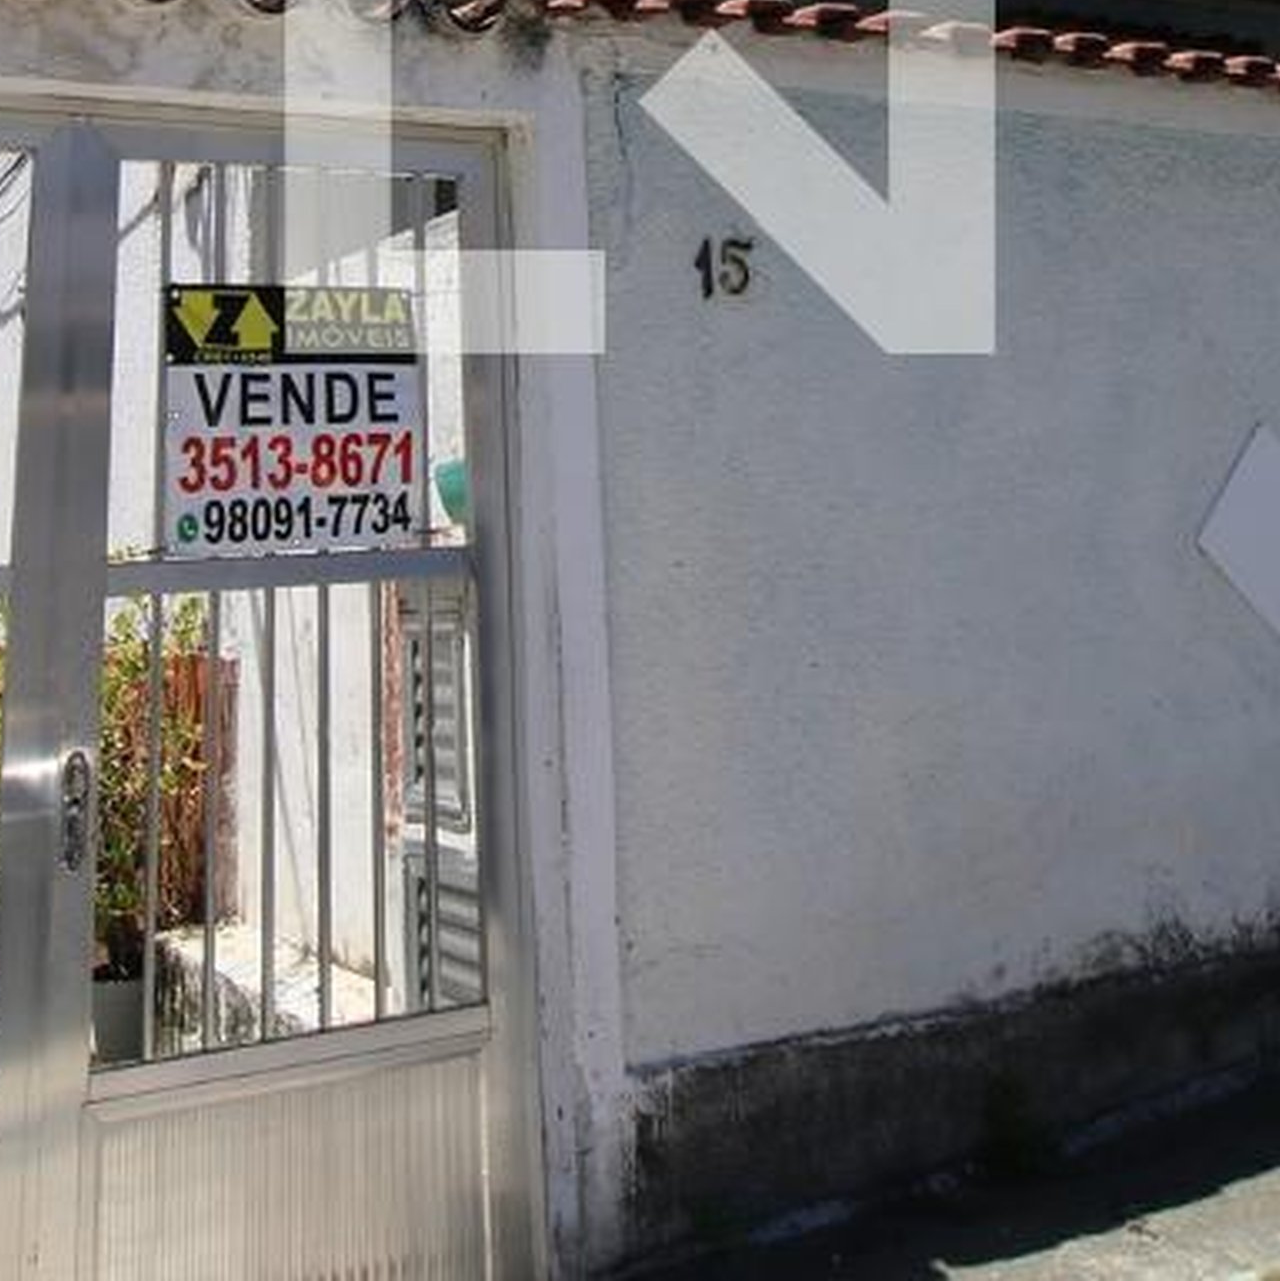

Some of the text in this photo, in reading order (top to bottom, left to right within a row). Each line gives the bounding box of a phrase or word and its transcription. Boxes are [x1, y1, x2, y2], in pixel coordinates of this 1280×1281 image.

[694, 236, 753, 300] 15
[285, 290, 407, 323] ZAYLA
[194, 372, 399, 427] VENDE
[178, 430, 413, 494] 3513-8671
[203, 491, 412, 544] 98091-7734
